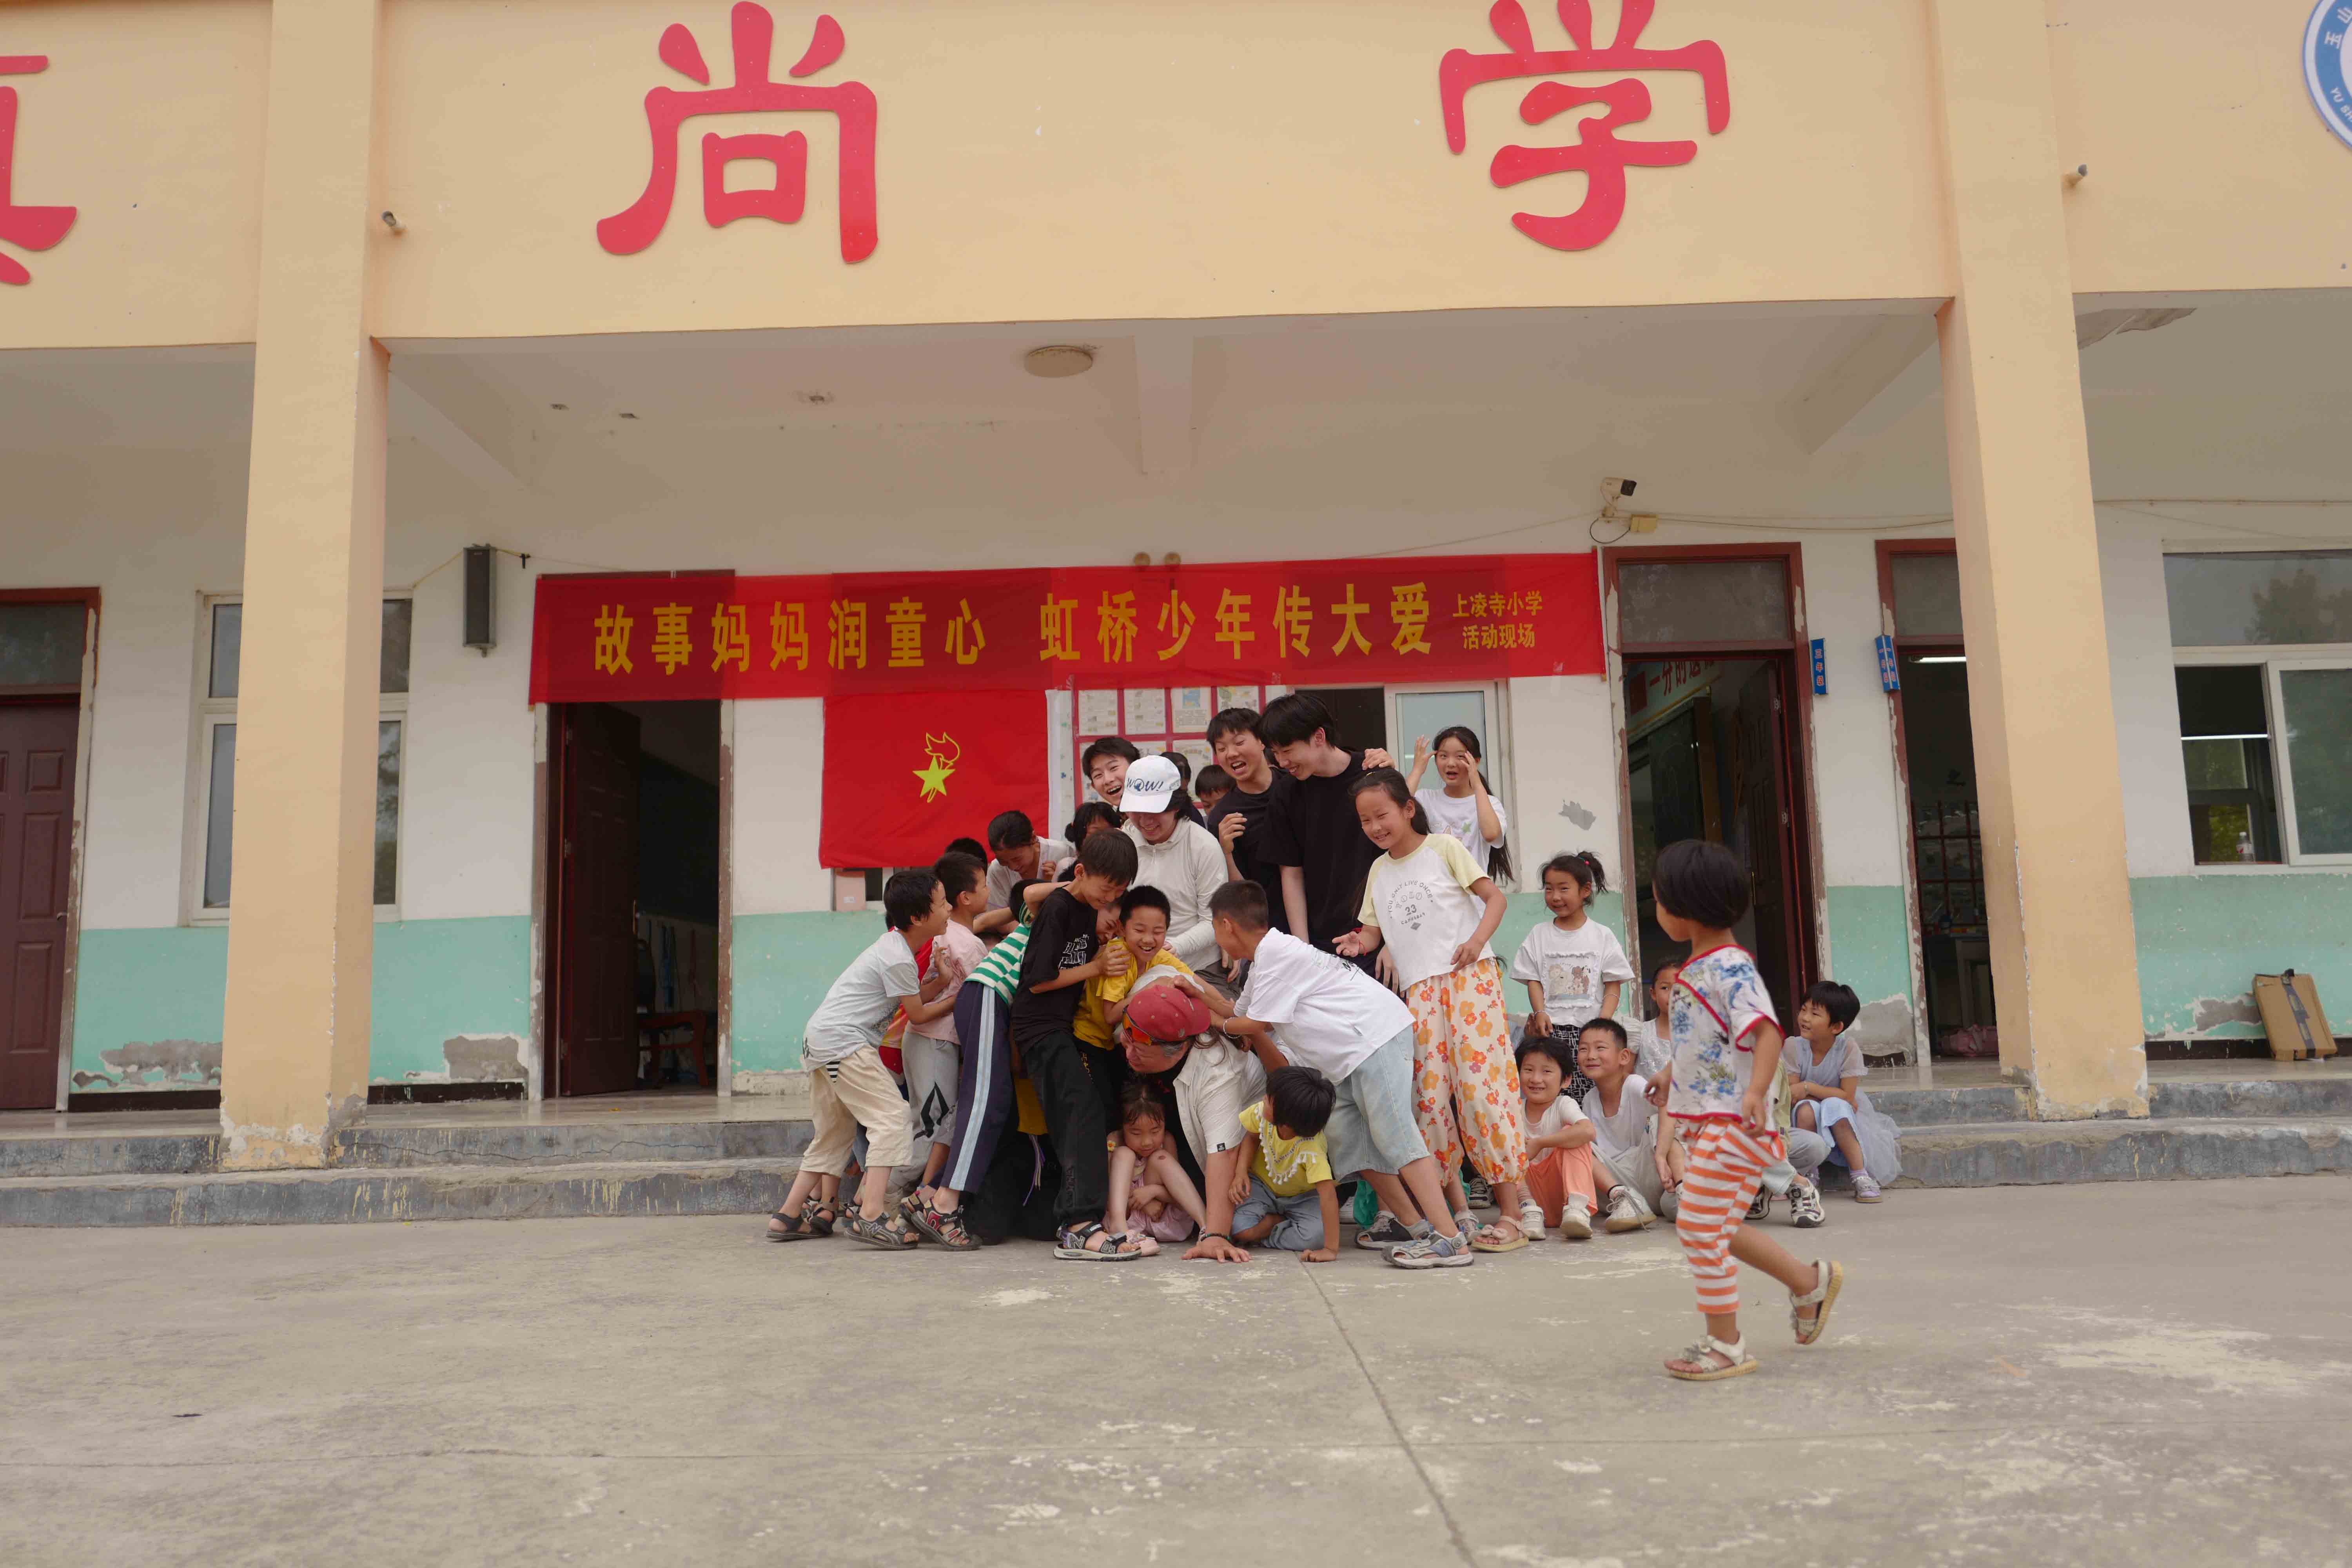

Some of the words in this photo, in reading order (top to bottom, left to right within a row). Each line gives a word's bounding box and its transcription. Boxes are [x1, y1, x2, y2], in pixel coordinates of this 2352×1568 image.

[597, 1, 878, 263] 尚
[1439, 0, 1730, 251] 学
[1452, 590, 1543, 617] 上凌寺小学
[594, 597, 985, 675] 故事妈妈润童心
[1040, 582, 1431, 662] 虹桥少年传大爱
[1463, 622, 1535, 649] 活动现场
[1392, 883, 1402, 898] ONLY
[1419, 882, 1433, 898] ONCE
[1405, 904, 1417, 916] 23
